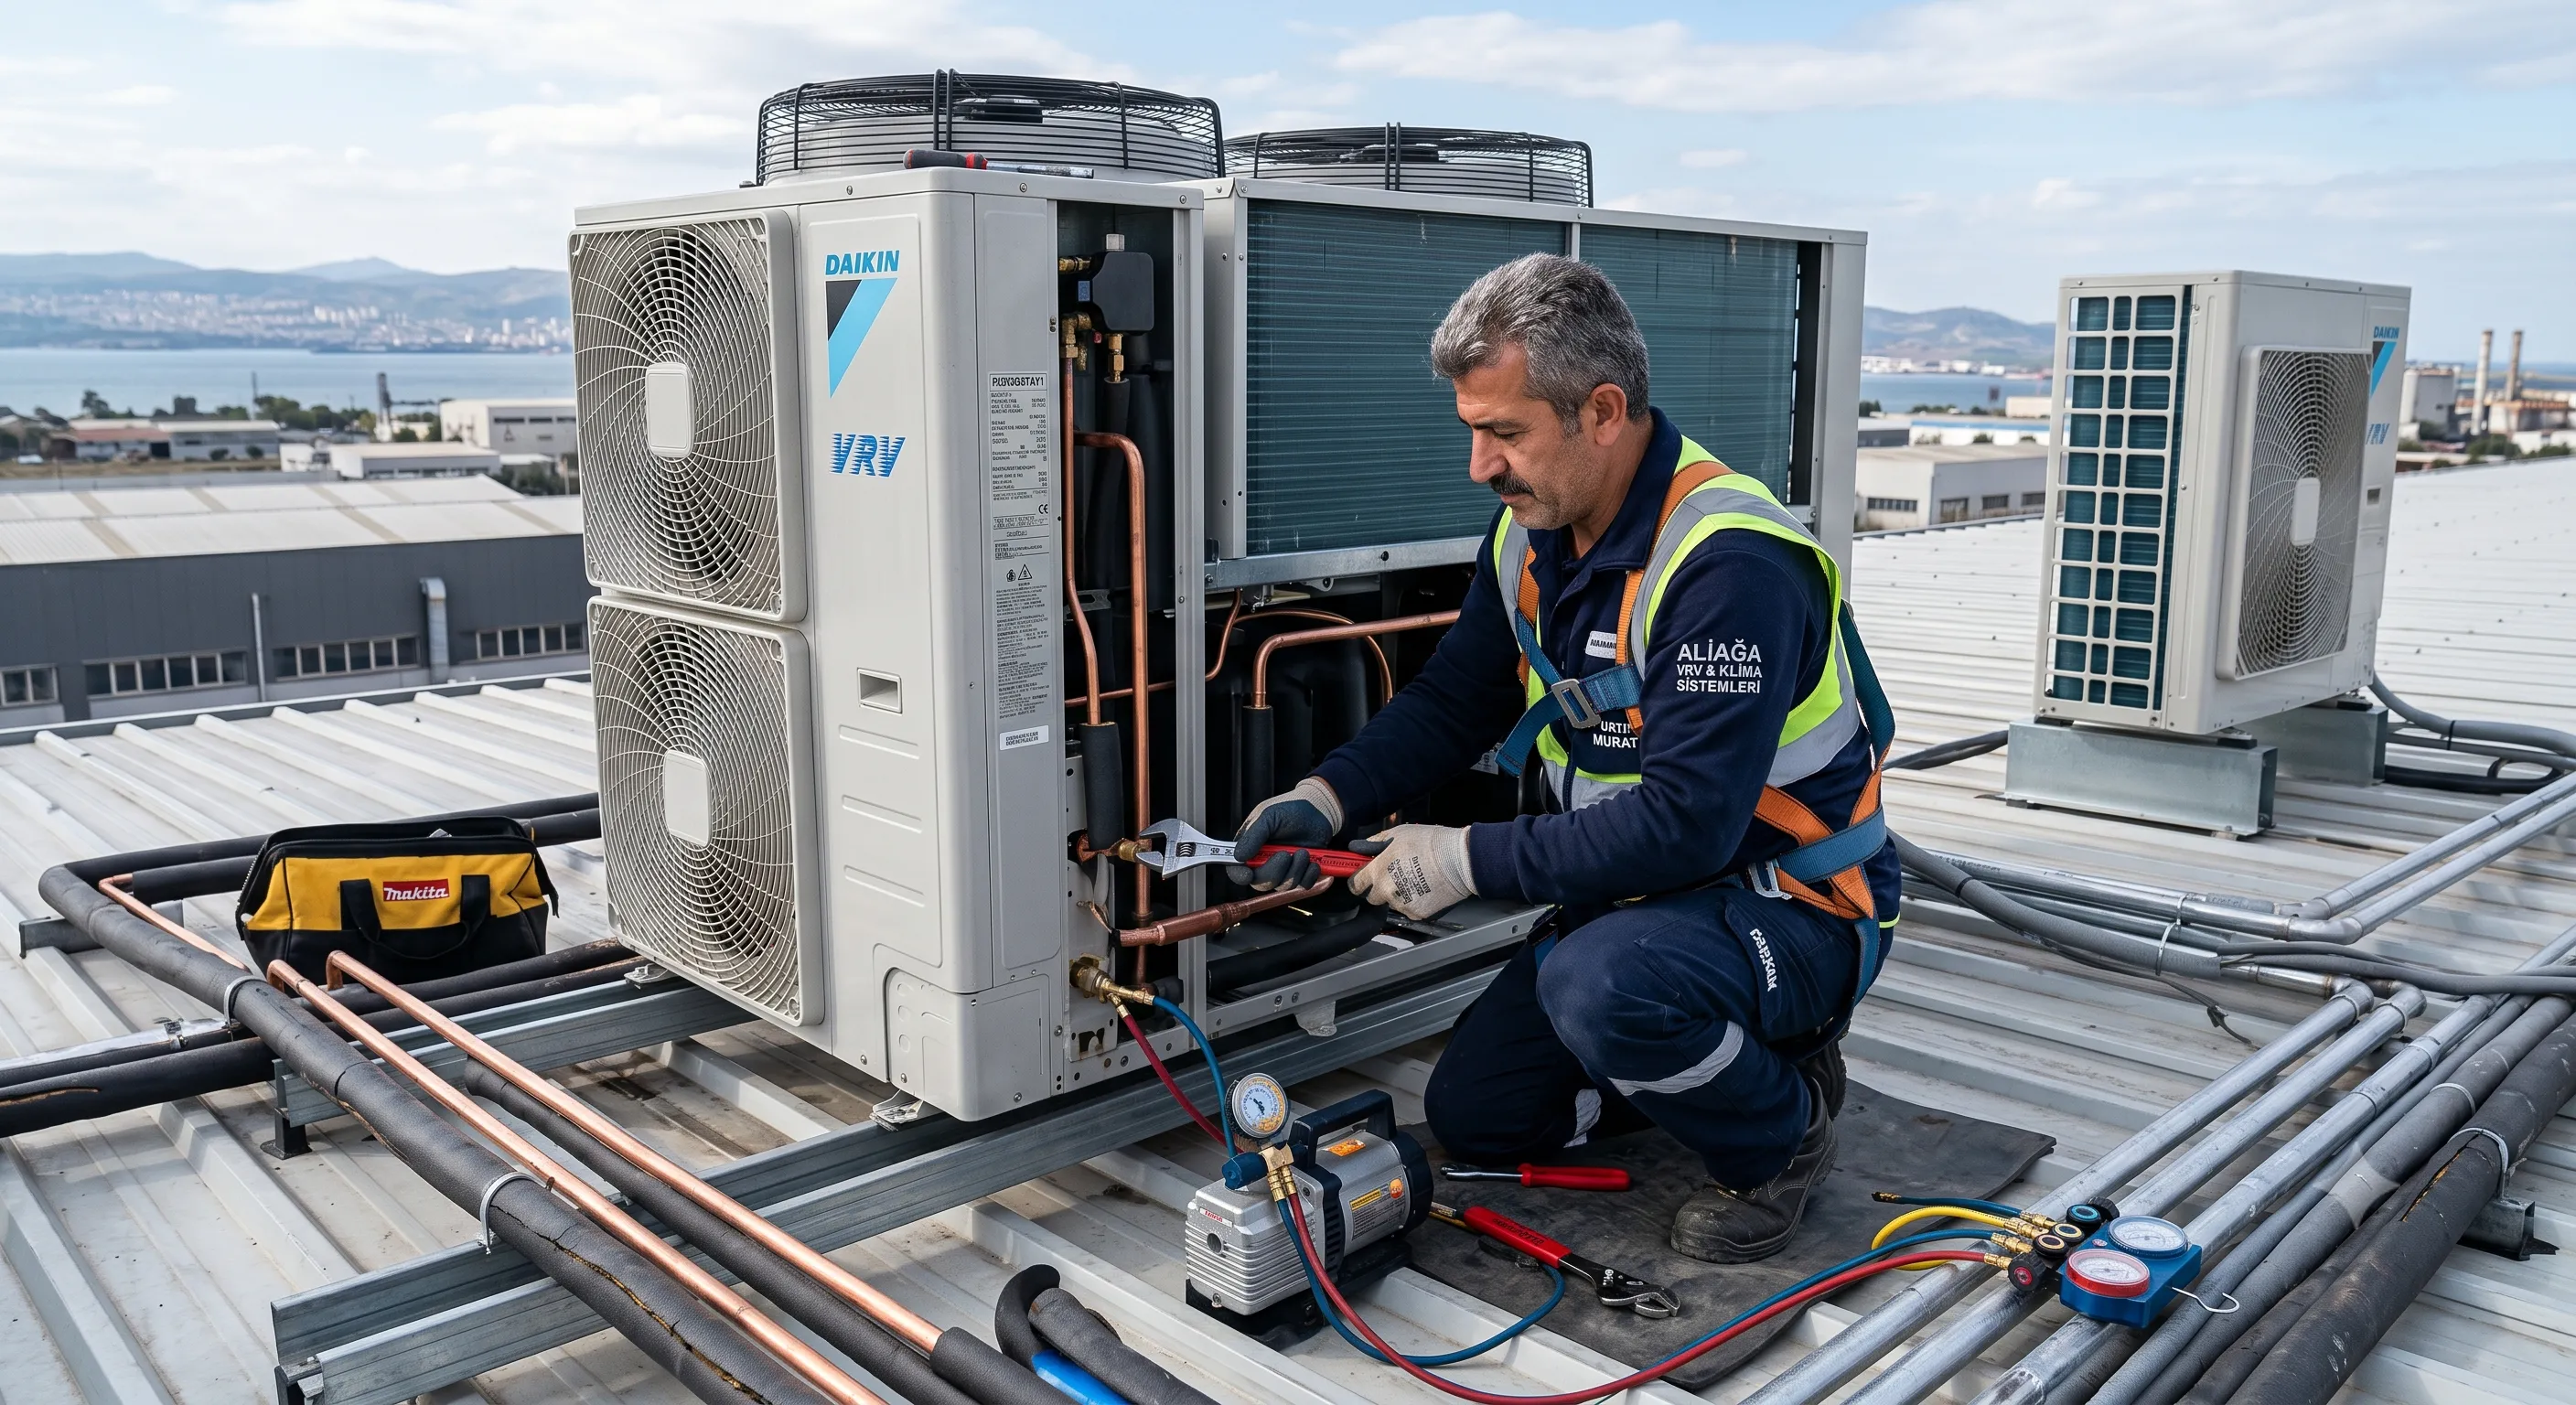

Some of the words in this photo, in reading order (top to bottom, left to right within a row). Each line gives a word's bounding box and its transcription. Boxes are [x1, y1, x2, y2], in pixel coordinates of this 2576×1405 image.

[825, 250, 900, 276] DAIKIN
[2373, 326, 2399, 339] DAIKIN
[829, 433, 907, 477] VRV
[1677, 638, 1762, 663] ALİAĞA
[1676, 664, 1702, 677] VRV
[1705, 664, 1716, 677] &
[1719, 663, 1763, 678] KLİMA
[1676, 677, 1761, 693] SİSTEMLERİ
[1593, 733, 1638, 748] MURAT
